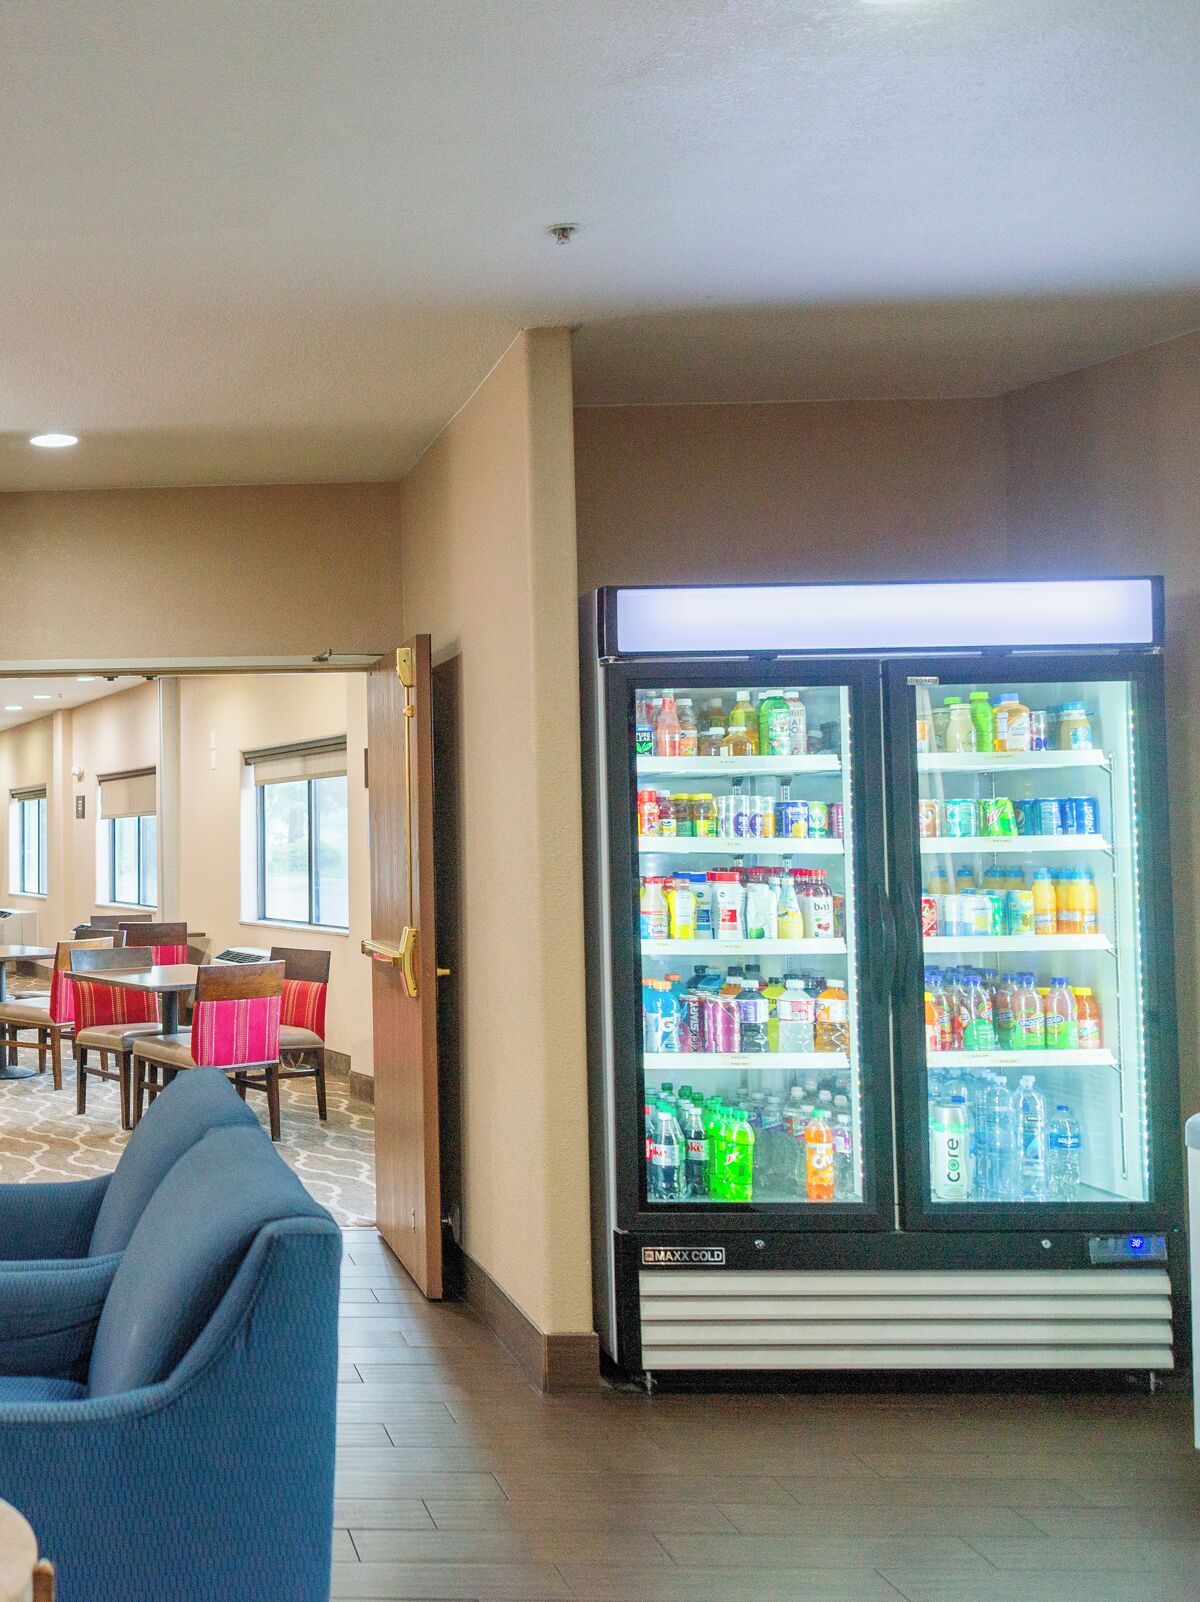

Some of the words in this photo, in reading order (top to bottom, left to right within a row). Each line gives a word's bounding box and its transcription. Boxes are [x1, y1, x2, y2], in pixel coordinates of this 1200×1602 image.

[947, 1138, 960, 1182] core
[655, 1250, 690, 1261] MAXX
[691, 1251, 723, 1261] COLD
